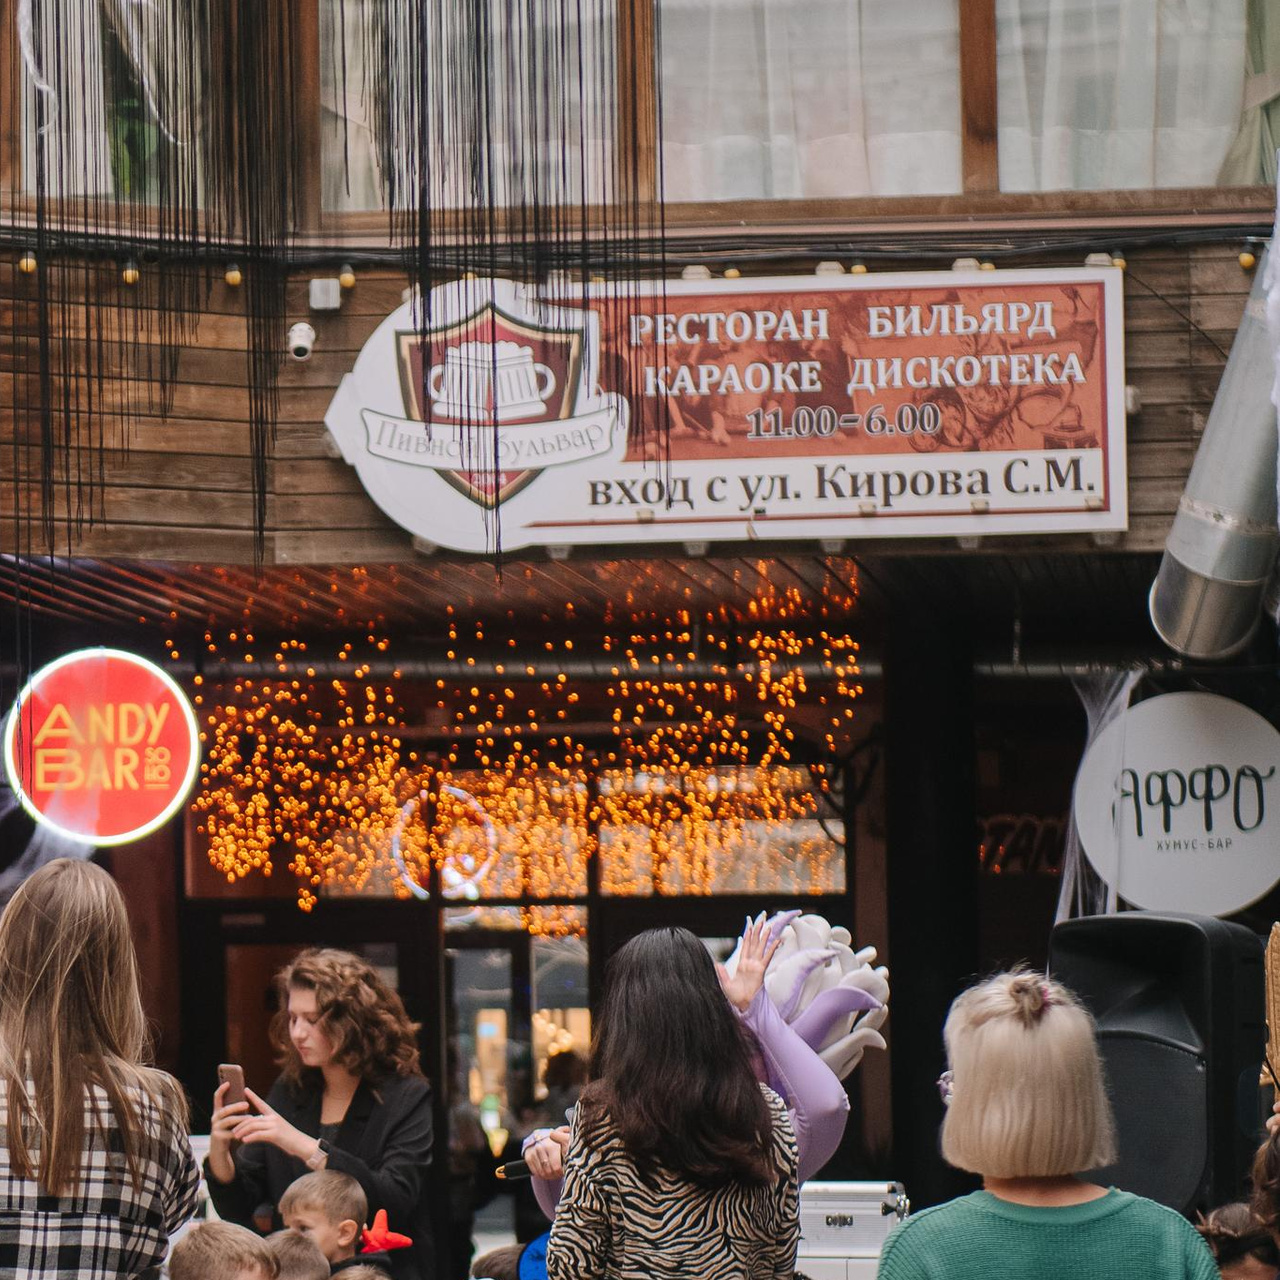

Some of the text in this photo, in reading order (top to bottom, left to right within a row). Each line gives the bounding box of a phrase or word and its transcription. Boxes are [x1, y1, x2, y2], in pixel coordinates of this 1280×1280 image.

[630, 301, 1057, 347] РЕСТОРАН БИЛЬЯРД
[644, 352, 1087, 397] КАРАОКЕ ДИСКОТЕКА
[588, 476, 694, 510] вход
[706, 475, 728, 503] с
[738, 473, 802, 512] ул.
[814, 464, 991, 508] Кирова
[33, 702, 170, 746] ANDY
[34, 747, 140, 791] BAR
[1156, 837, 1234, 852] ХУМУС-БАР
